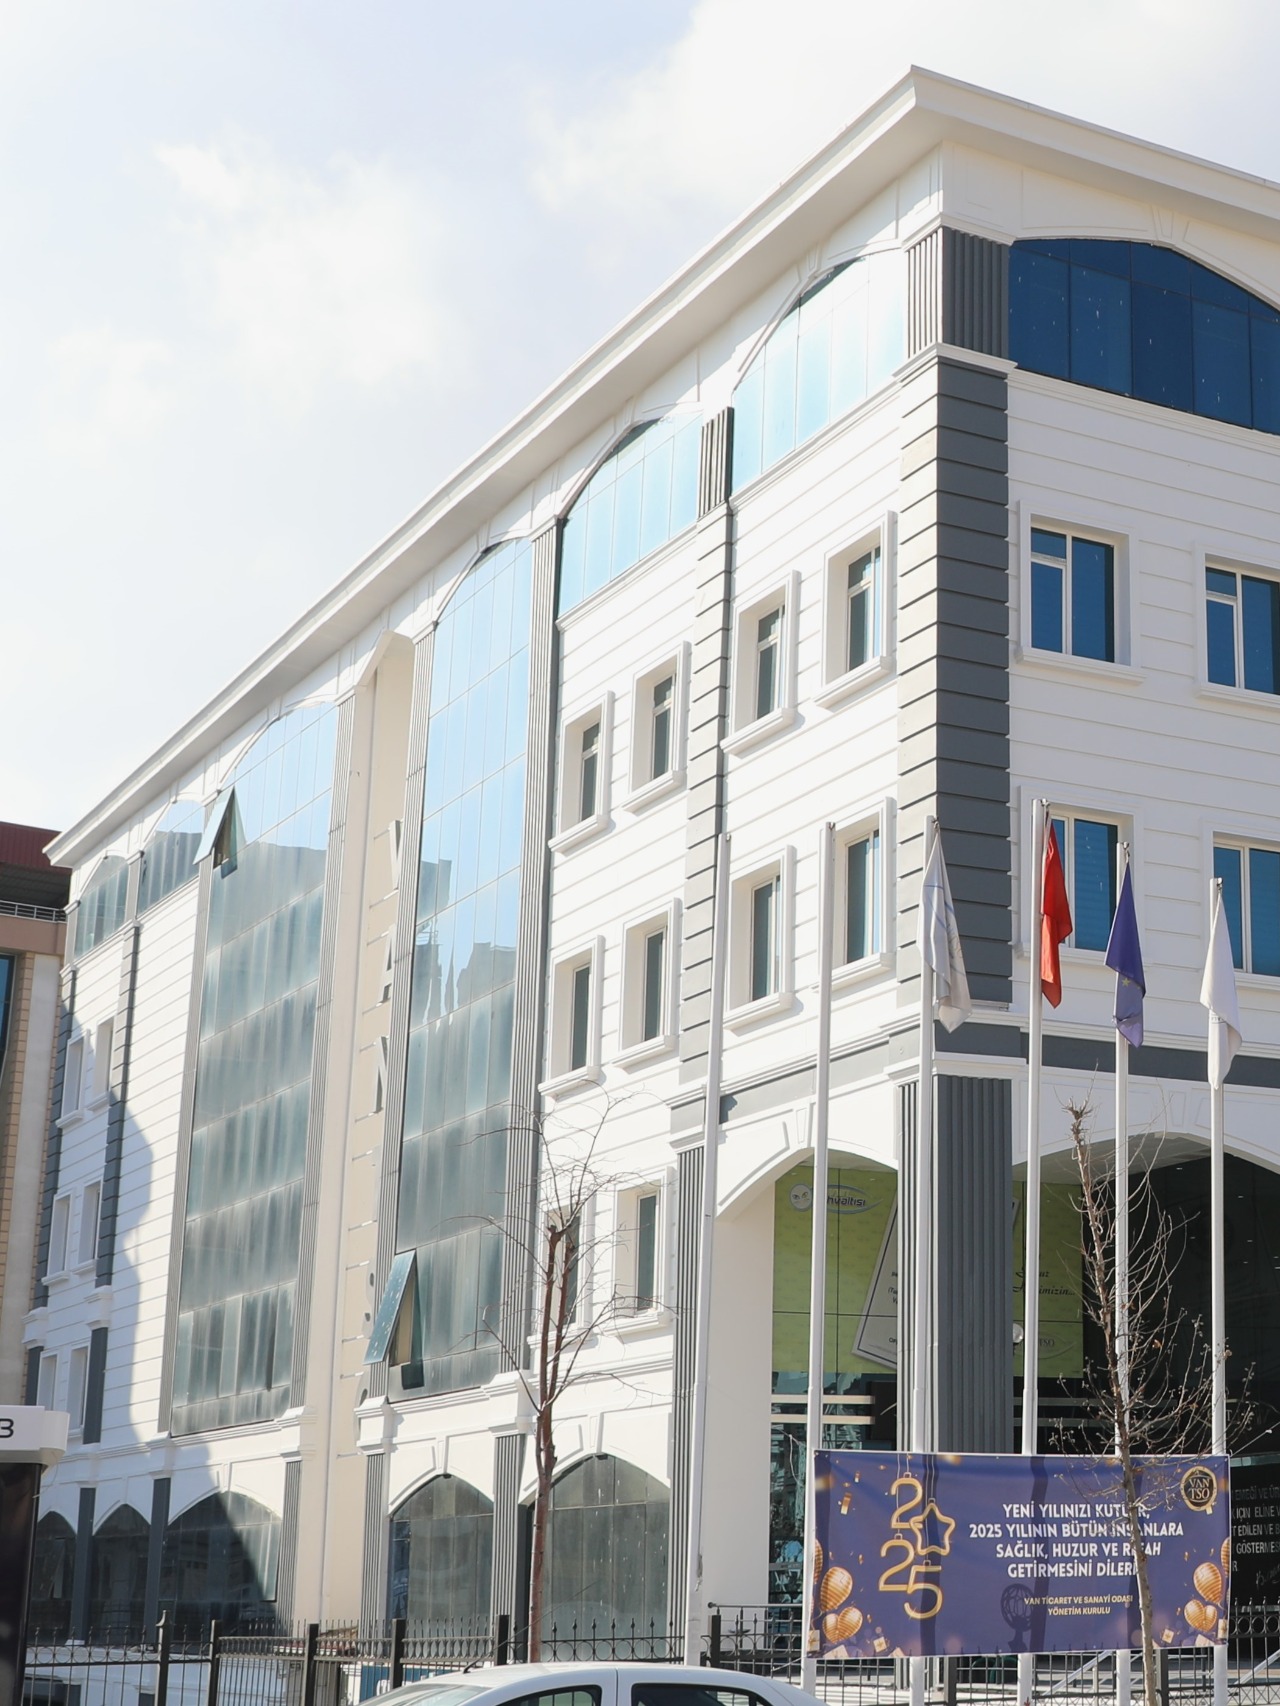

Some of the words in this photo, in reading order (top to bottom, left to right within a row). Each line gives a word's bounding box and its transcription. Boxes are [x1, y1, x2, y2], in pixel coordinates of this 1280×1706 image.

[1189, 1478, 1210, 1488] VAN
[1190, 1488, 1210, 1500] TSO
[1003, 1501, 1035, 1518] YENİ
[1039, 1504, 1091, 1518] YILINIZI
[1096, 1503, 1150, 1519] KUTLR,
[969, 1523, 1002, 1538] 2025
[1006, 1523, 1058, 1538] YILININ
[1062, 1520, 1108, 1538] BÜTÜN
[996, 1540, 1049, 1559] SAĞLIK,
[1053, 1543, 1098, 1558] HUZUR
[1102, 1543, 1119, 1557] VE
[1008, 1559, 1092, 1578] GETİRMESİNİ
[1024, 1597, 1040, 1605] VAN
[1042, 1595, 1072, 1605] TİCARET
[1073, 1596, 1083, 1604] VE
[1084, 1594, 1110, 1604] SANAYİ
[1112, 1595, 1133, 1603] ODASI
[1048, 1606, 1081, 1616] YÖNETİM
[1083, 1606, 1110, 1615] KURULU
